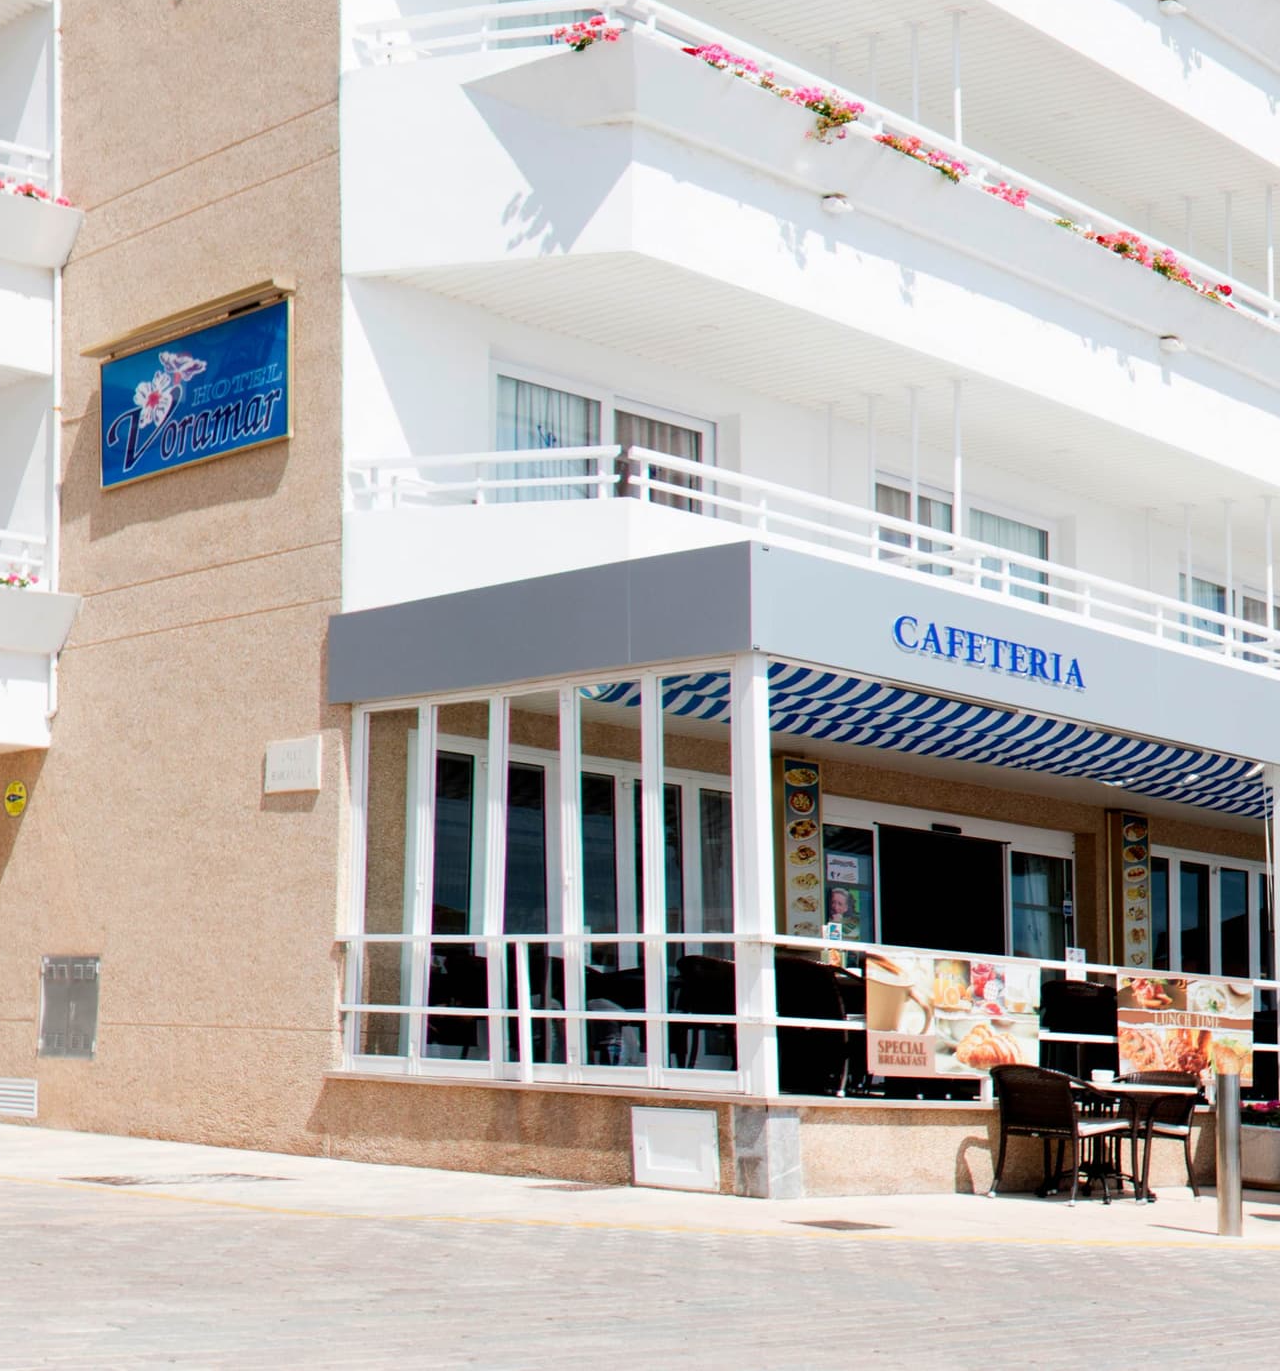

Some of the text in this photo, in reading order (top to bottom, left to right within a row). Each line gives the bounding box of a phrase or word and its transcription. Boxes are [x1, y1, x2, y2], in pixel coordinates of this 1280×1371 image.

[191, 363, 283, 407] HOTEL
[106, 385, 282, 472] Voramar
[893, 615, 1086, 689] CAFETERIA
[1153, 1011, 1221, 1028] LUNCH TIME
[877, 1040, 927, 1056] SPECIAL
[878, 1054, 928, 1067] BREAKFAST
